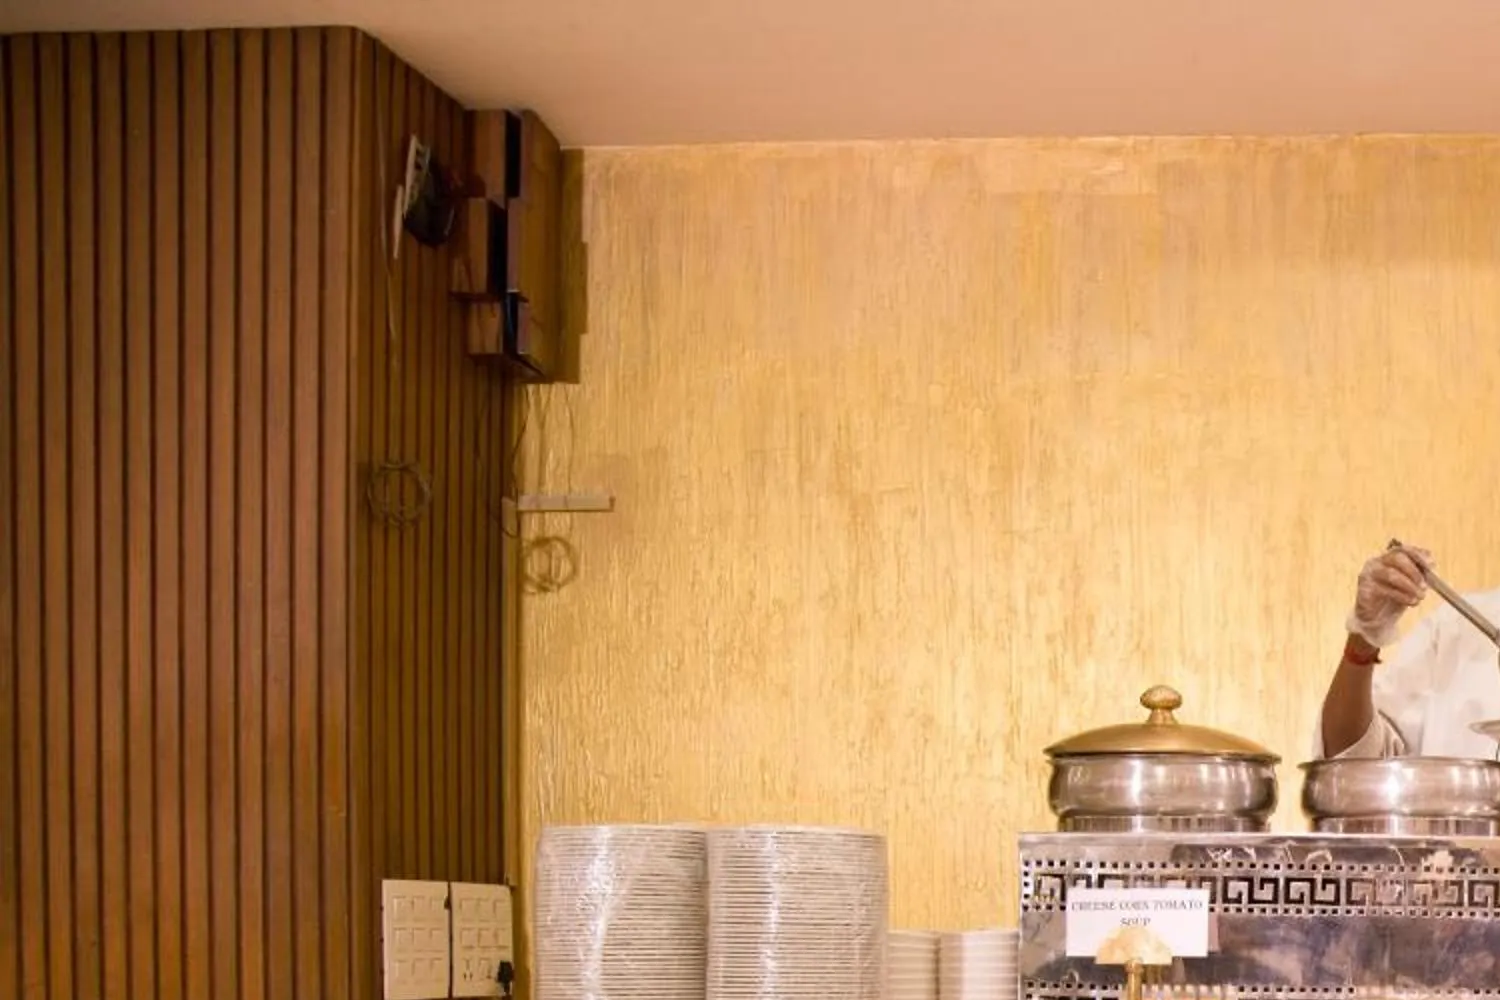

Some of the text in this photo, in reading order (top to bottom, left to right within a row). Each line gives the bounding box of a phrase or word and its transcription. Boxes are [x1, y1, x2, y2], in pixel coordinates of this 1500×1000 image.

[1071, 900, 1115, 911] CHEESE
[1153, 899, 1203, 911] TOMATO
[1120, 917, 1151, 926] SOUP
